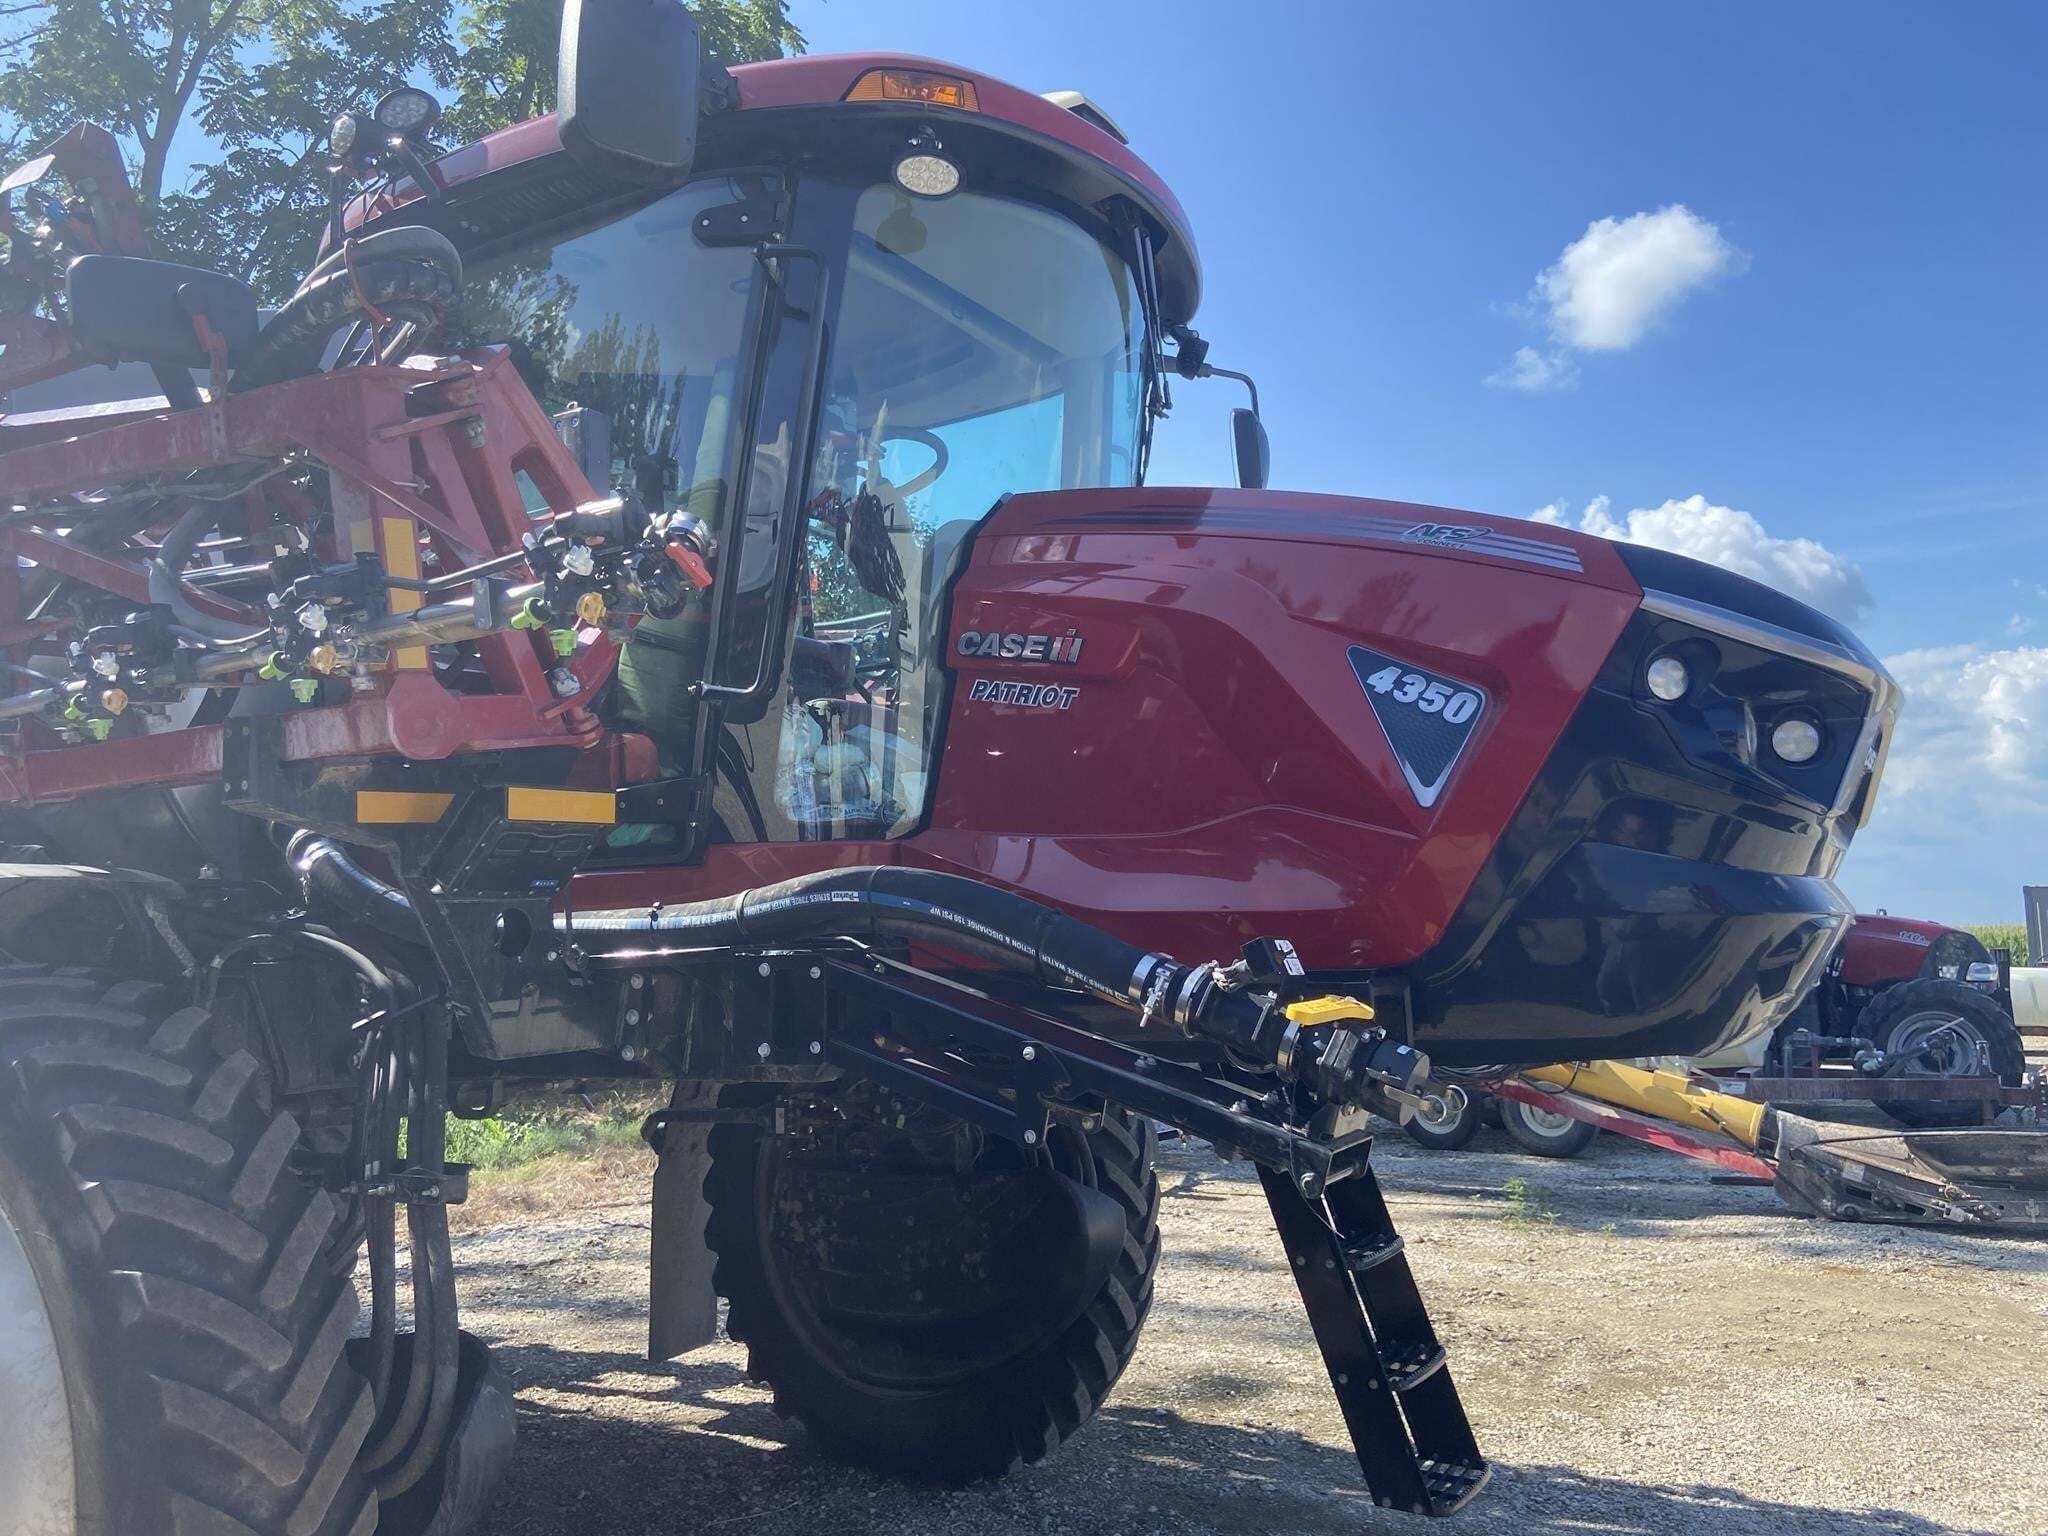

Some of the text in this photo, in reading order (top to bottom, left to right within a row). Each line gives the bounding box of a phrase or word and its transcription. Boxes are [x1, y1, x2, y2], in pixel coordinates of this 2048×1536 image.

[1402, 522, 1474, 540] AFS
[957, 631, 1048, 660] CASE
[969, 679, 1081, 709] PATRIOT
[1366, 666, 1479, 724] 4350
[930, 906, 941, 916] WP
[942, 910, 953, 920] PSI
[967, 919, 1004, 941] DISCHARGE
[1012, 940, 1036, 956] UCTION
